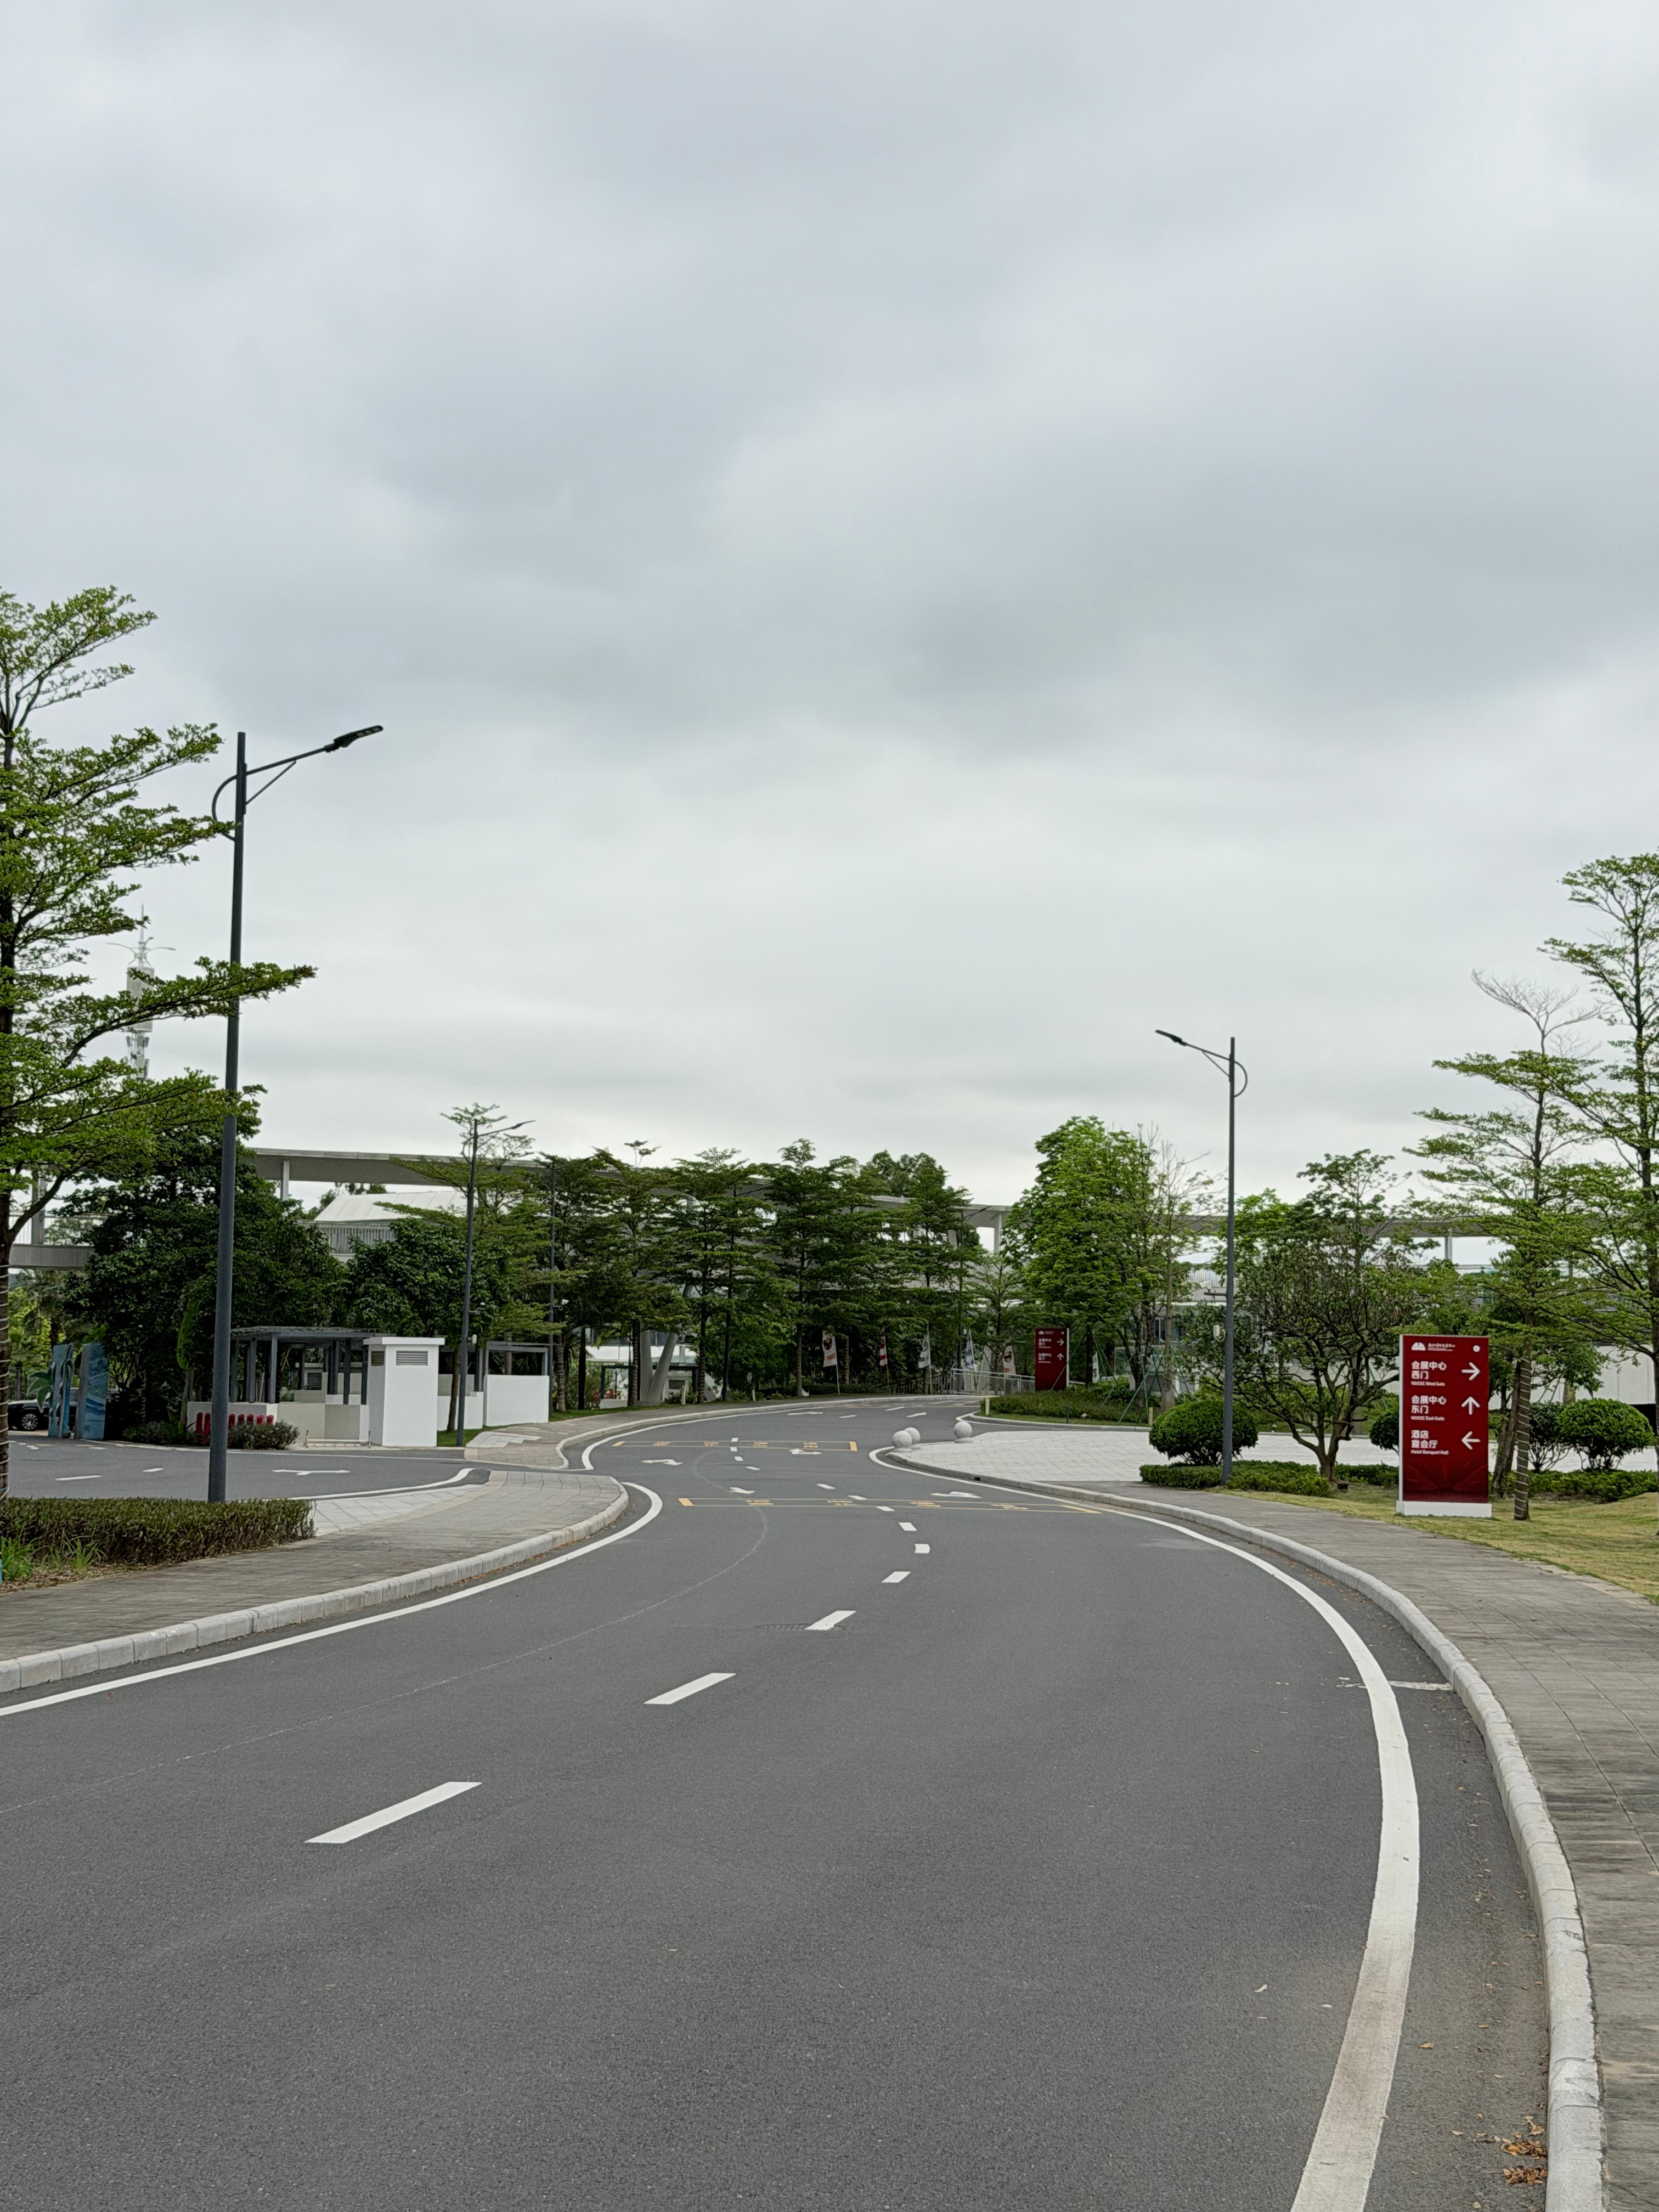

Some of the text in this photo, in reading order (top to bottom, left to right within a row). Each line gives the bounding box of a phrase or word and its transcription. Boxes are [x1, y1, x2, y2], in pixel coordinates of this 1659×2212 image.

[1411, 1361, 1447, 1370] 会展中心
[1411, 1370, 1429, 1380] 西门
[1411, 1395, 1447, 1404] 会展中心
[1411, 1405, 1429, 1414] 东门
[1411, 1430, 1429, 1438] 酒店
[1411, 1440, 1438, 1449] 宴会厅
